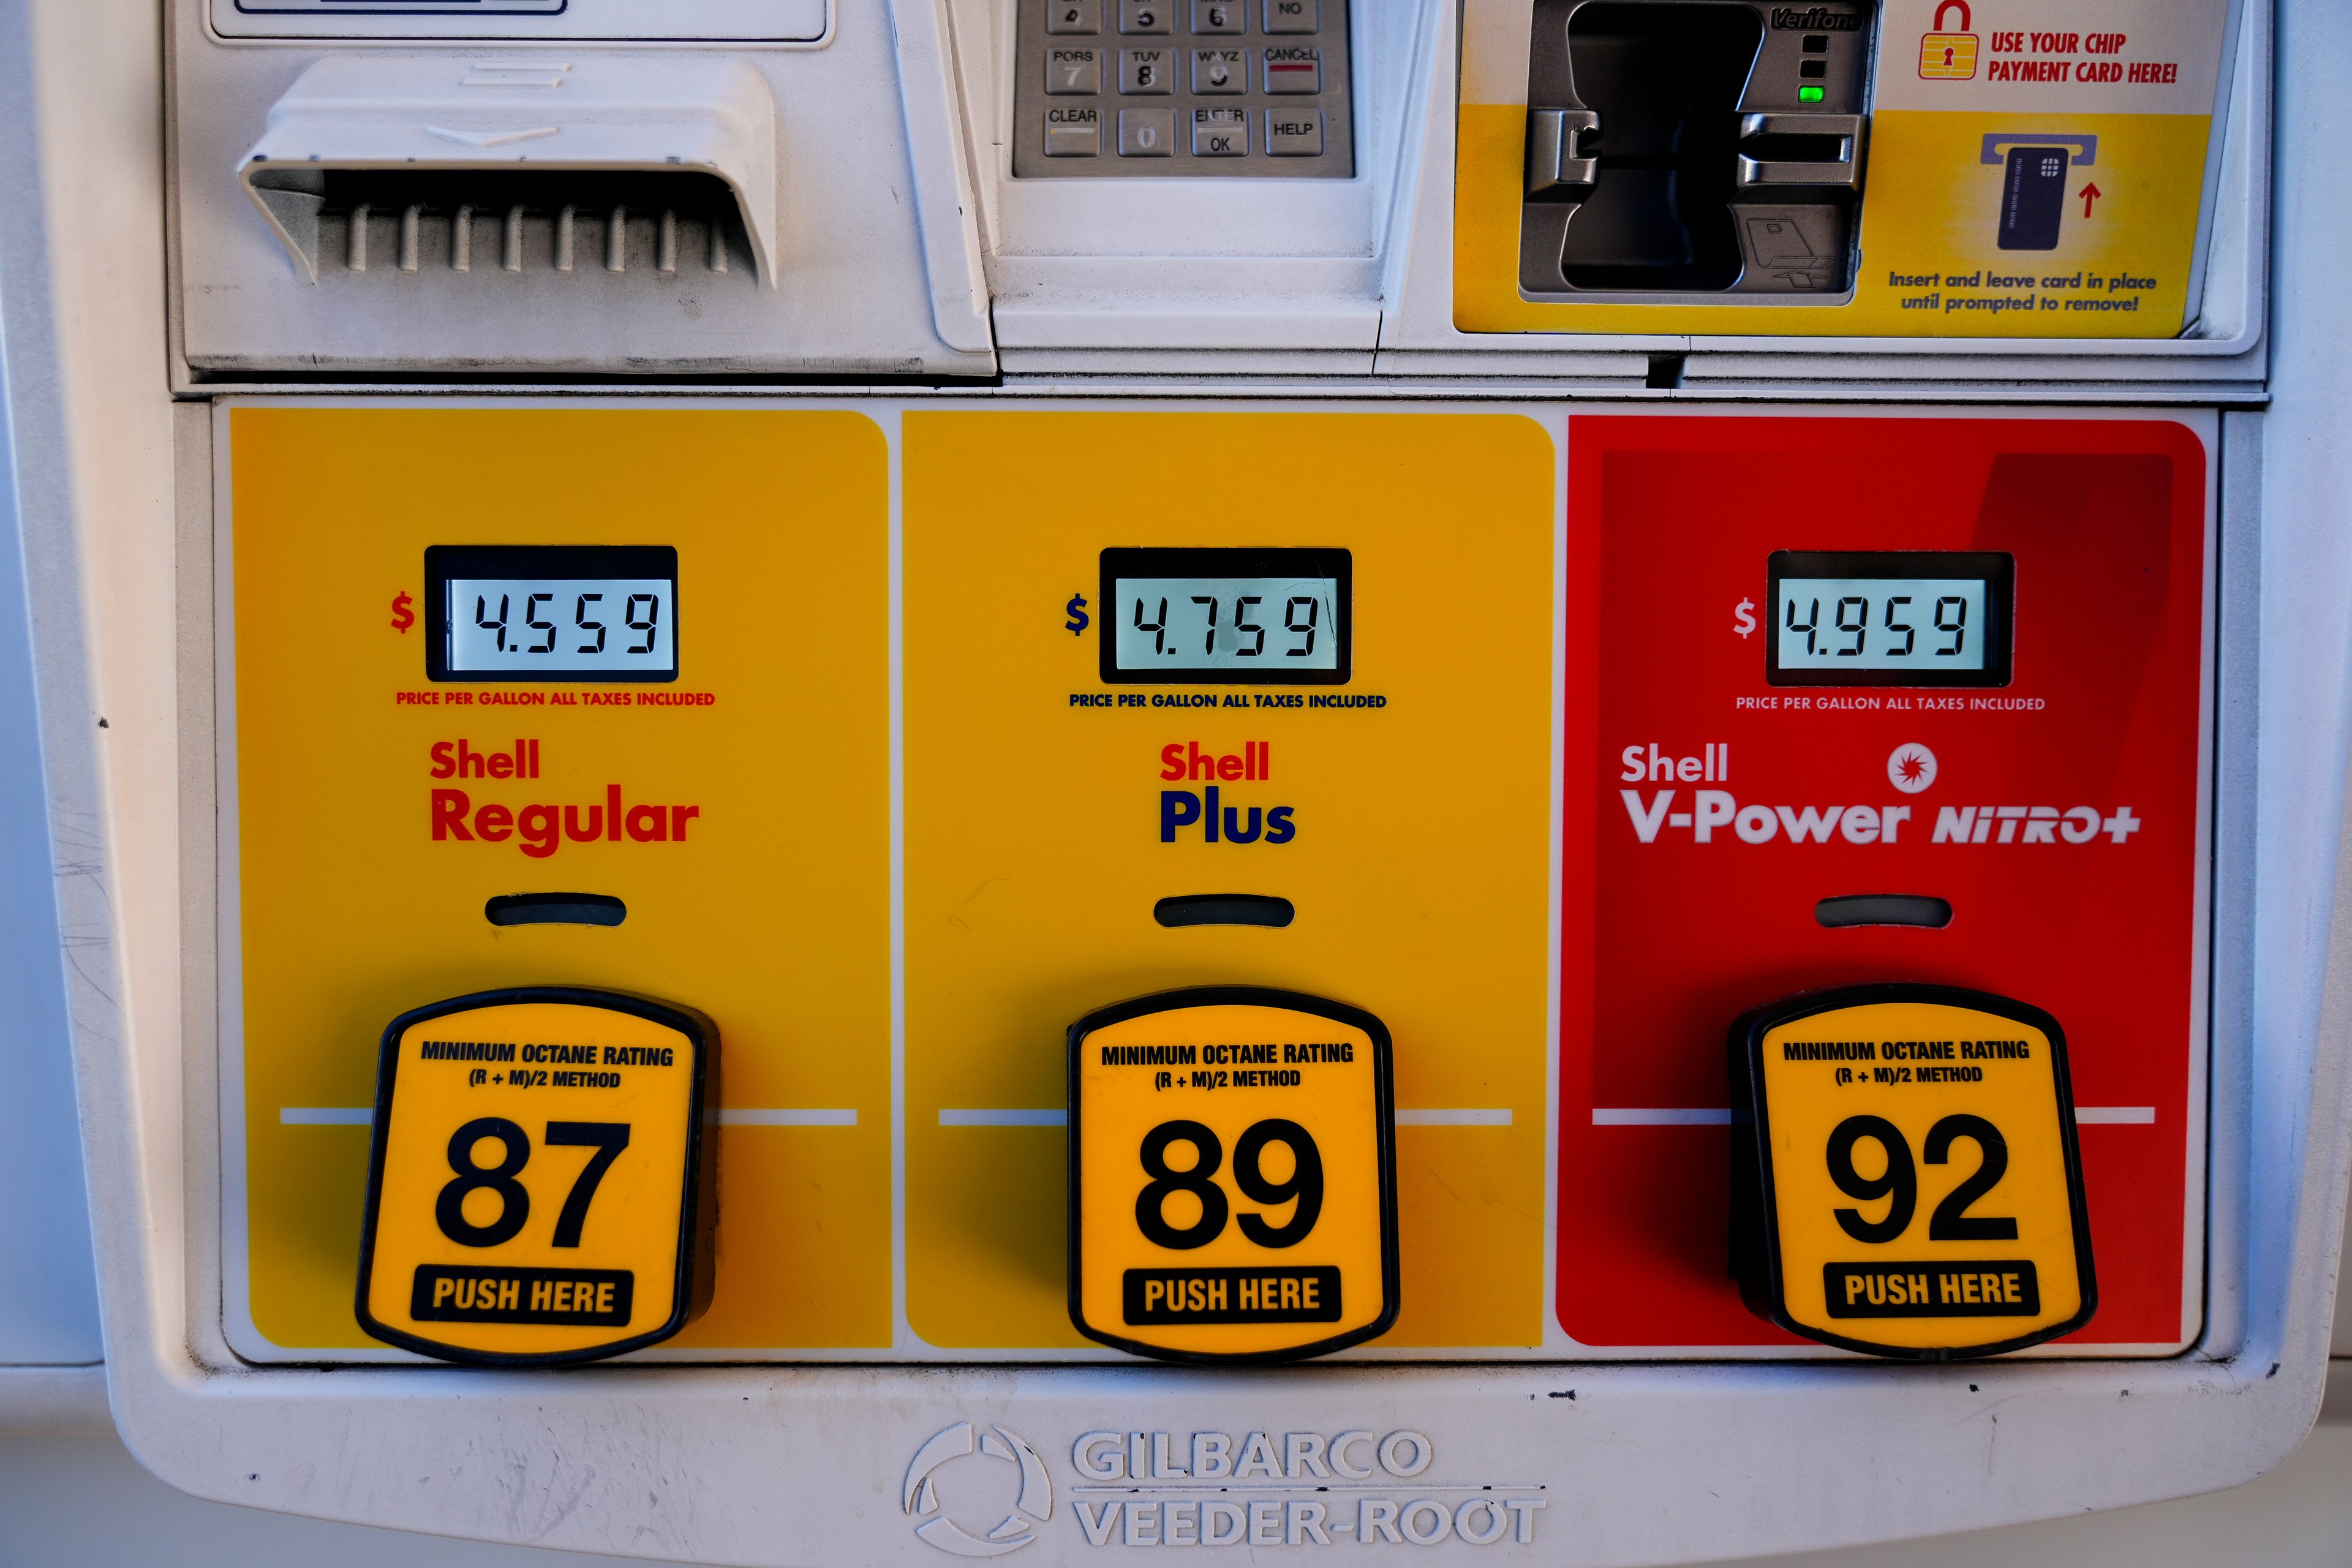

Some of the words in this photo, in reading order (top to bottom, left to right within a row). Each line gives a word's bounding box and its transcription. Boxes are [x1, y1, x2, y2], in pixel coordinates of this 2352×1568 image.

[1279, 4, 1302, 15] NO
[1774, 8, 1862, 28] Verifone
[1991, 32, 2024, 53] USE
[2030, 33, 2079, 53] YOUR
[2085, 34, 2126, 54] CHIP
[1132, 51, 1161, 61] TUV
[1199, 52, 1238, 61] WXYZ
[1265, 49, 1316, 61] CANCEL
[1064, 67, 1082, 86] 7
[1137, 66, 1156, 87] 8
[1210, 66, 1228, 86] 9
[1988, 61, 2071, 82] PAYMENT
[2076, 62, 2123, 83] CARD
[2128, 63, 2177, 83] HERE!
[1049, 110, 1097, 122] CLEAR
[1196, 110, 1244, 122] ENTER
[1274, 123, 1313, 135] HELP
[1210, 137, 1230, 152] OK
[1889, 271, 1940, 287] Insert
[1945, 271, 1981, 287] and
[1986, 271, 2035, 288] leave
[2041, 272, 2082, 288] card
[2087, 273, 2103, 288] in
[2108, 273, 2156, 293] place
[1902, 293, 1940, 309] until
[1945, 294, 2035, 314] prompted
[2040, 297, 2059, 311] to
[2065, 296, 2139, 311] remove!
[390, 591, 415, 634] $
[475, 594, 659, 654] 4.559
[1065, 593, 1089, 636] $
[1134, 596, 1318, 657] 4.759
[1733, 597, 1756, 639] $
[1785, 597, 1967, 656] 4.959
[396, 692, 439, 705] PRICE
[445, 693, 473, 705] PER
[478, 693, 545, 706] GALLON
[549, 693, 577, 706] ALL
[582, 693, 631, 706] TAXES
[637, 693, 715, 706] INCLUDED
[1069, 693, 1112, 707] PRICE
[1118, 694, 1147, 707] PER
[1152, 694, 1217, 707] GALLON
[1222, 695, 1250, 707] ALL
[1254, 695, 1303, 707] TAXES
[1309, 695, 1387, 708] INCLUDED
[1736, 697, 1777, 709] PRICE
[1784, 697, 1811, 709] PER
[1816, 697, 1880, 710] GALLON
[1885, 698, 1912, 710] ALL
[1917, 698, 1964, 710] TAXES
[1970, 698, 2045, 711] INCLUDED
[430, 739, 540, 779] Shell
[1160, 741, 1269, 781] Shell
[1621, 743, 1727, 782] Shell
[431, 784, 699, 858] Regular
[1161, 786, 1296, 844] Plus
[1619, 789, 1911, 845] V-Power
[421, 1041, 516, 1062] MINIMUM
[521, 1044, 597, 1065] OCTANE
[603, 1047, 674, 1066] RATING
[1102, 1046, 1196, 1065] MINIMUM
[1202, 1044, 1278, 1065] OCTANE
[1284, 1043, 1354, 1063] RATING
[1784, 1042, 1876, 1061] MINIMUM
[1882, 1041, 1955, 1060] OCTANE
[1961, 1040, 2030, 1059] RATING
[469, 1069, 487, 1088] (R
[492, 1074, 504, 1085] +
[509, 1071, 548, 1088] M)/2
[552, 1072, 621, 1088] METHOD
[1155, 1072, 1172, 1091] (R
[1176, 1076, 1187, 1088] +
[1192, 1071, 1228, 1090] M)/2
[1233, 1070, 1301, 1088] METHOD
[1836, 1068, 1853, 1086] (R
[1858, 1072, 1869, 1084] +
[1875, 1067, 1912, 1085] M)/2
[1917, 1066, 1983, 1083] METHOD
[435, 1117, 631, 1248] 87
[1135, 1118, 1324, 1250] 89
[1826, 1114, 2019, 1244] 92
[432, 1277, 520, 1310] PUSH
[530, 1281, 616, 1313] HERE
[1145, 1280, 1227, 1311] PUSH
[1240, 1278, 1320, 1310] HERE
[1845, 1275, 1931, 1306] PUSH
[1939, 1273, 2022, 1304] HERE
[1073, 1431, 1433, 1479] GILBARCO
[1074, 1499, 1548, 1546] VEEDER-ROOT
